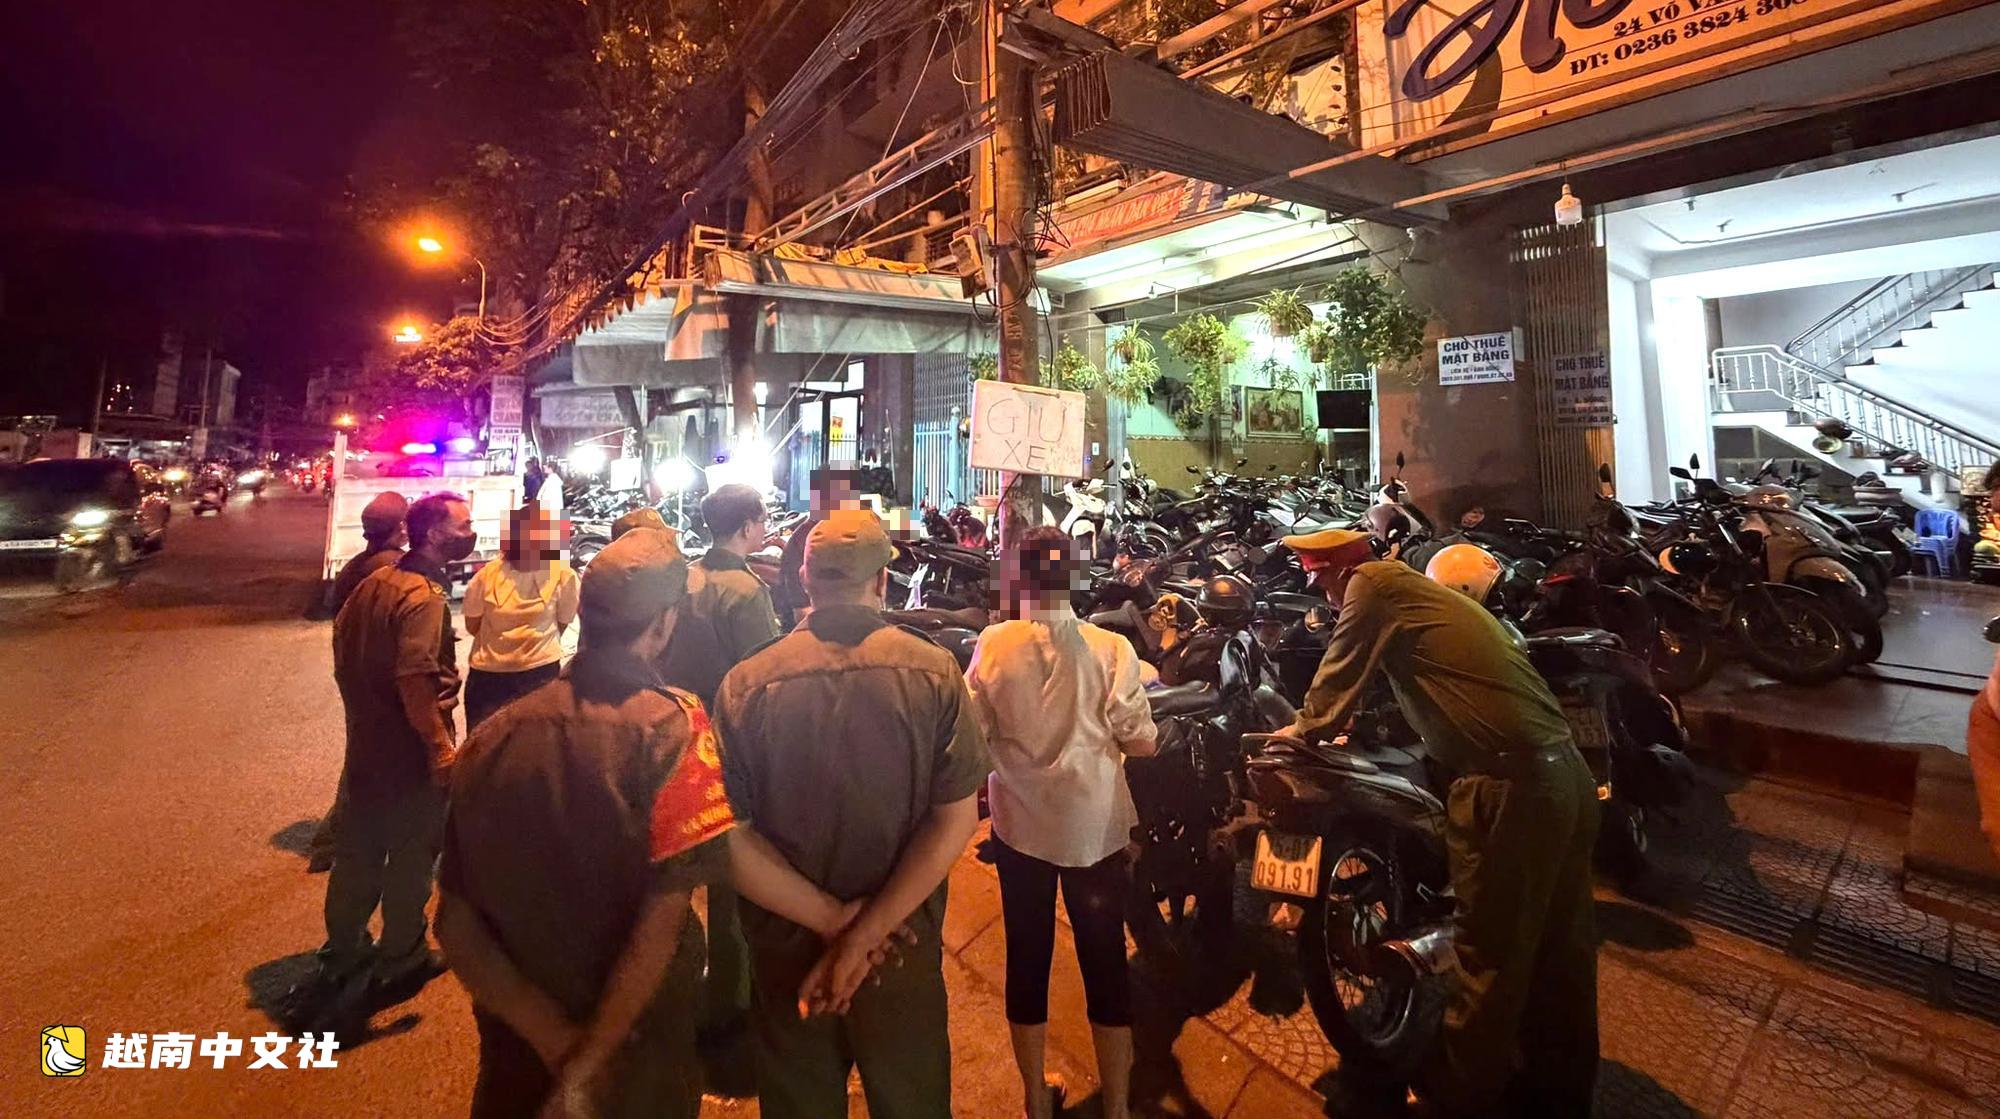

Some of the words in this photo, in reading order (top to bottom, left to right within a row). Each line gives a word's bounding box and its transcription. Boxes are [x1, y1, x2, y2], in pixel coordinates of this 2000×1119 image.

[1614, 16, 1643, 37] 24
[1569, 52, 1609, 75] ĐT:
[1614, 29, 1678, 60] 0236
[1683, 6, 1750, 39] 3824
[1443, 341, 1469, 352] CHO
[1474, 336, 1506, 349] THUÊ
[1555, 358, 1576, 371] CHO
[1001, 439, 1046, 472] XE
[1257, 860, 1313, 894] 091.91
